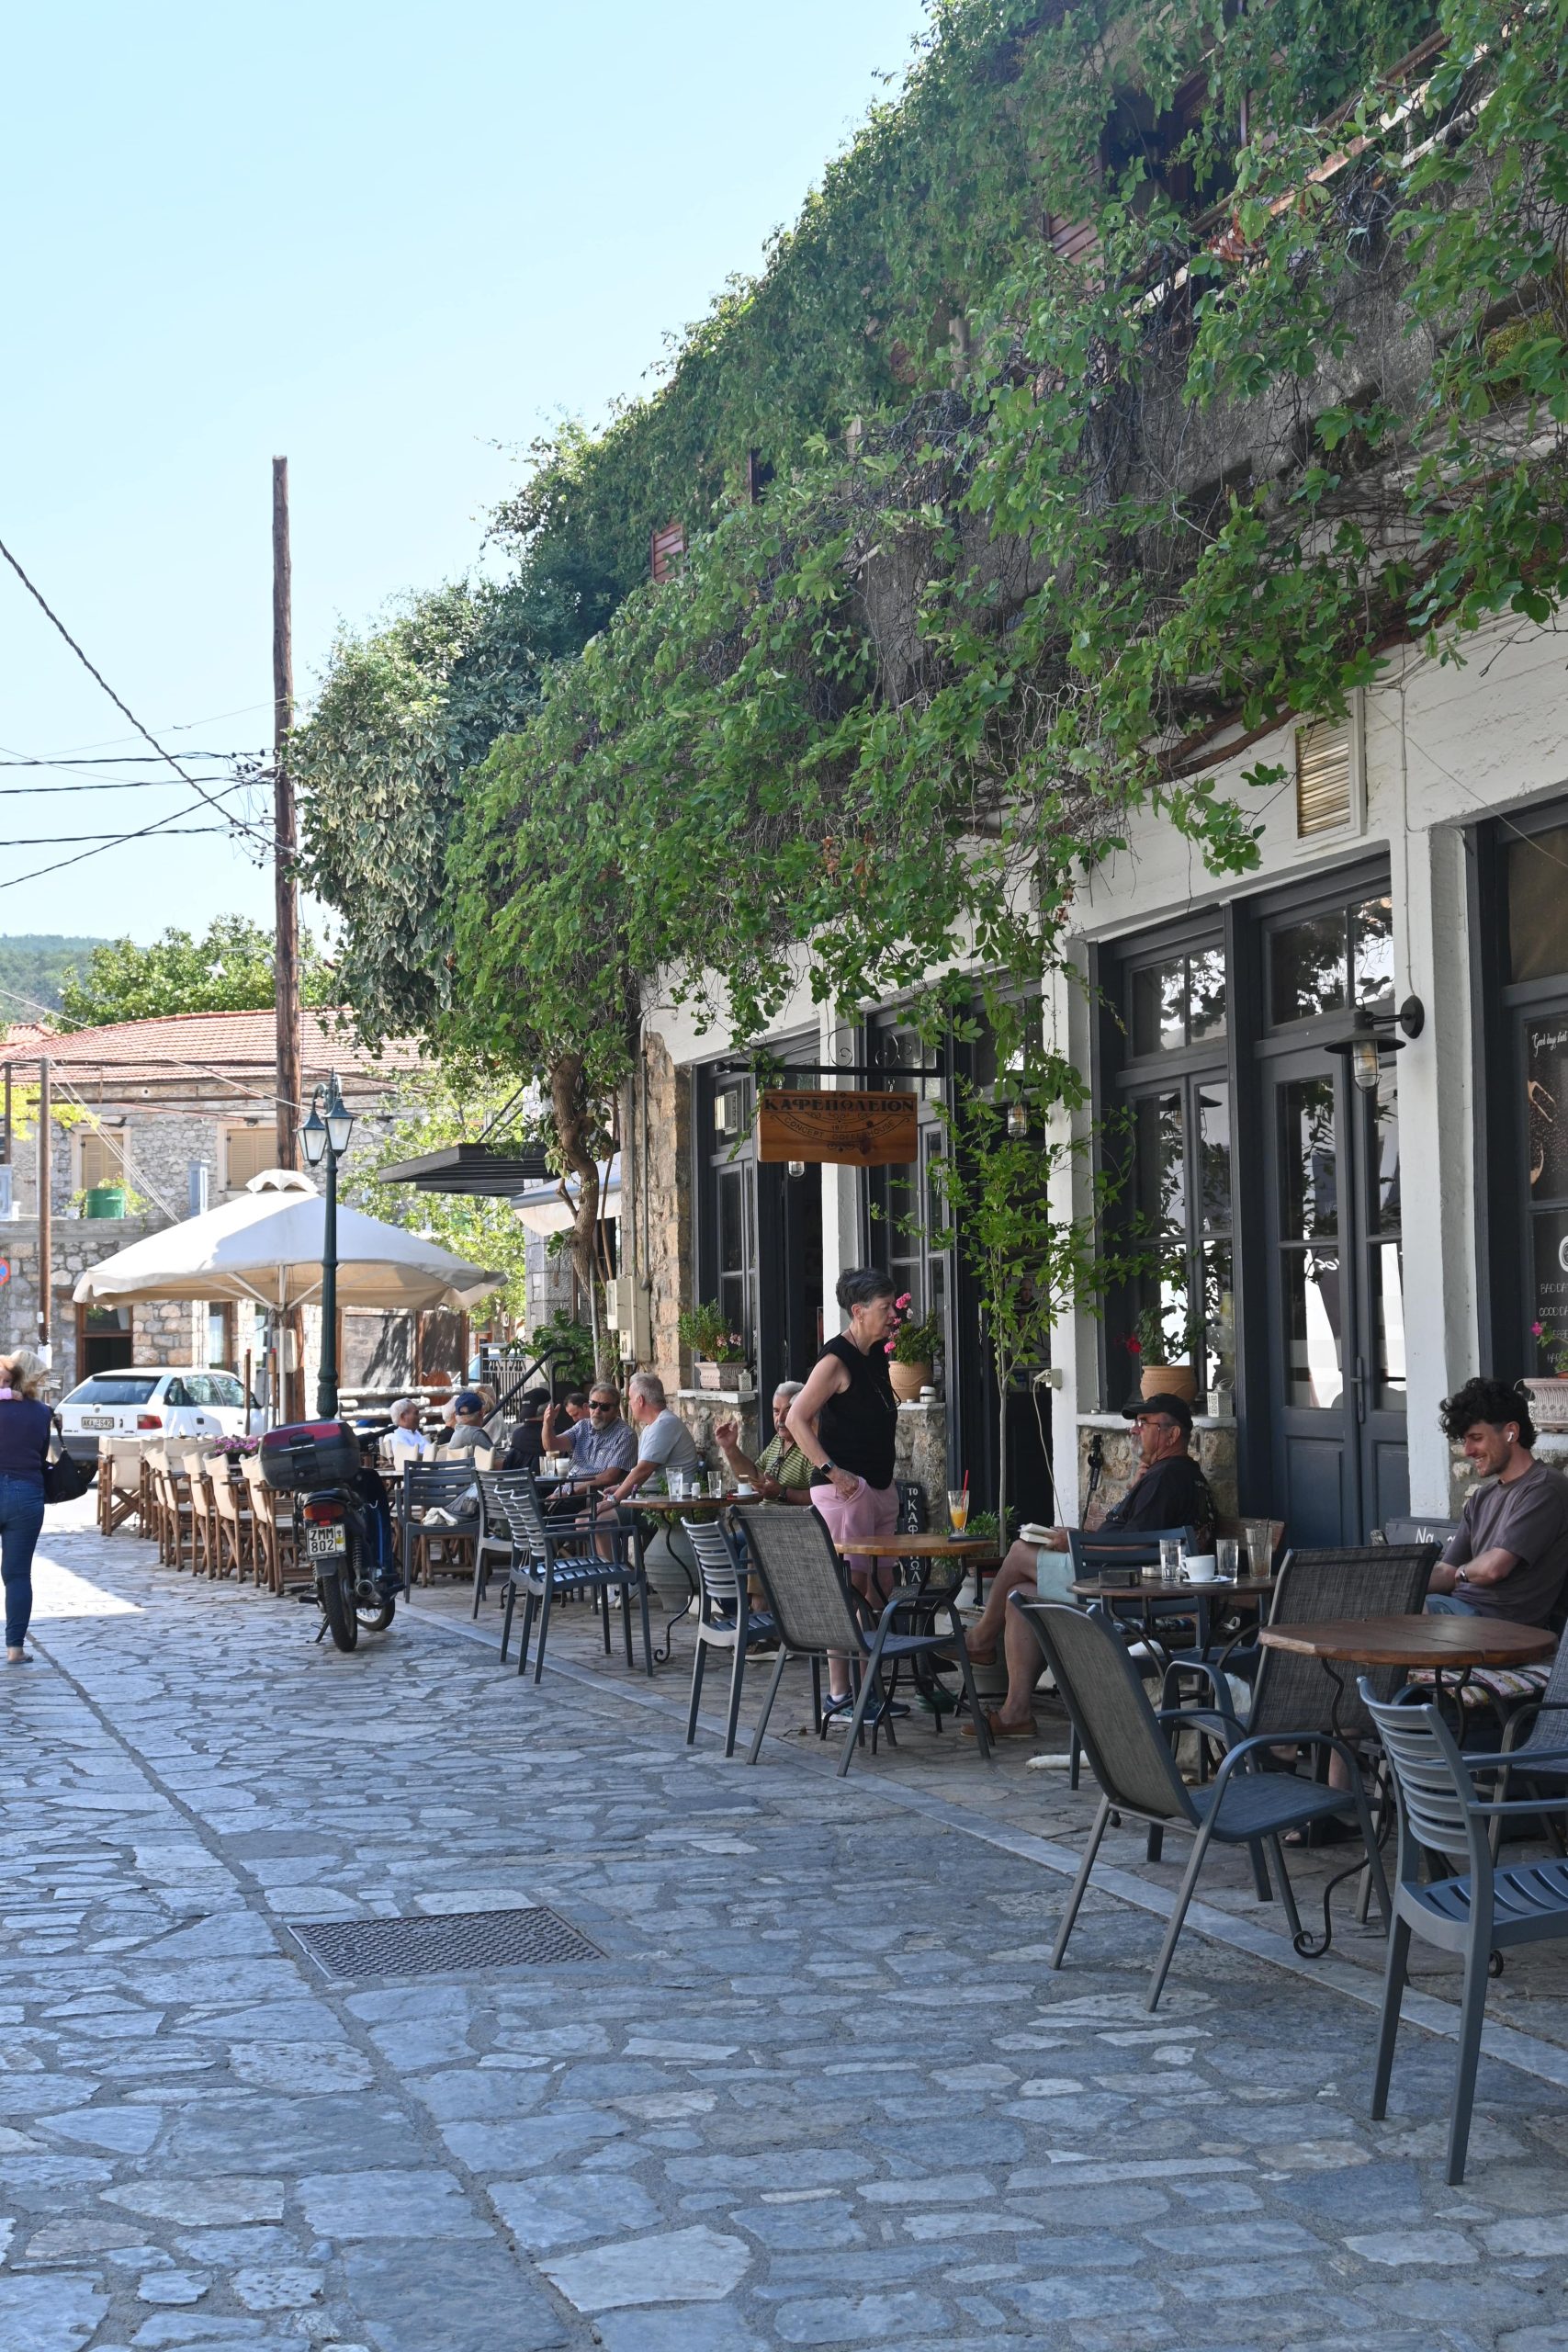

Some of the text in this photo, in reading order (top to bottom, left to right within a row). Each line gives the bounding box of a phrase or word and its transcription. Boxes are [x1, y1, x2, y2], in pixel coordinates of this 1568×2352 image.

[1531, 1032, 1546, 1057] Good
[784, 1116, 825, 1139] CONCEPT
[310, 1527, 334, 1541] ZMM
[310, 1539, 334, 1553] 802
